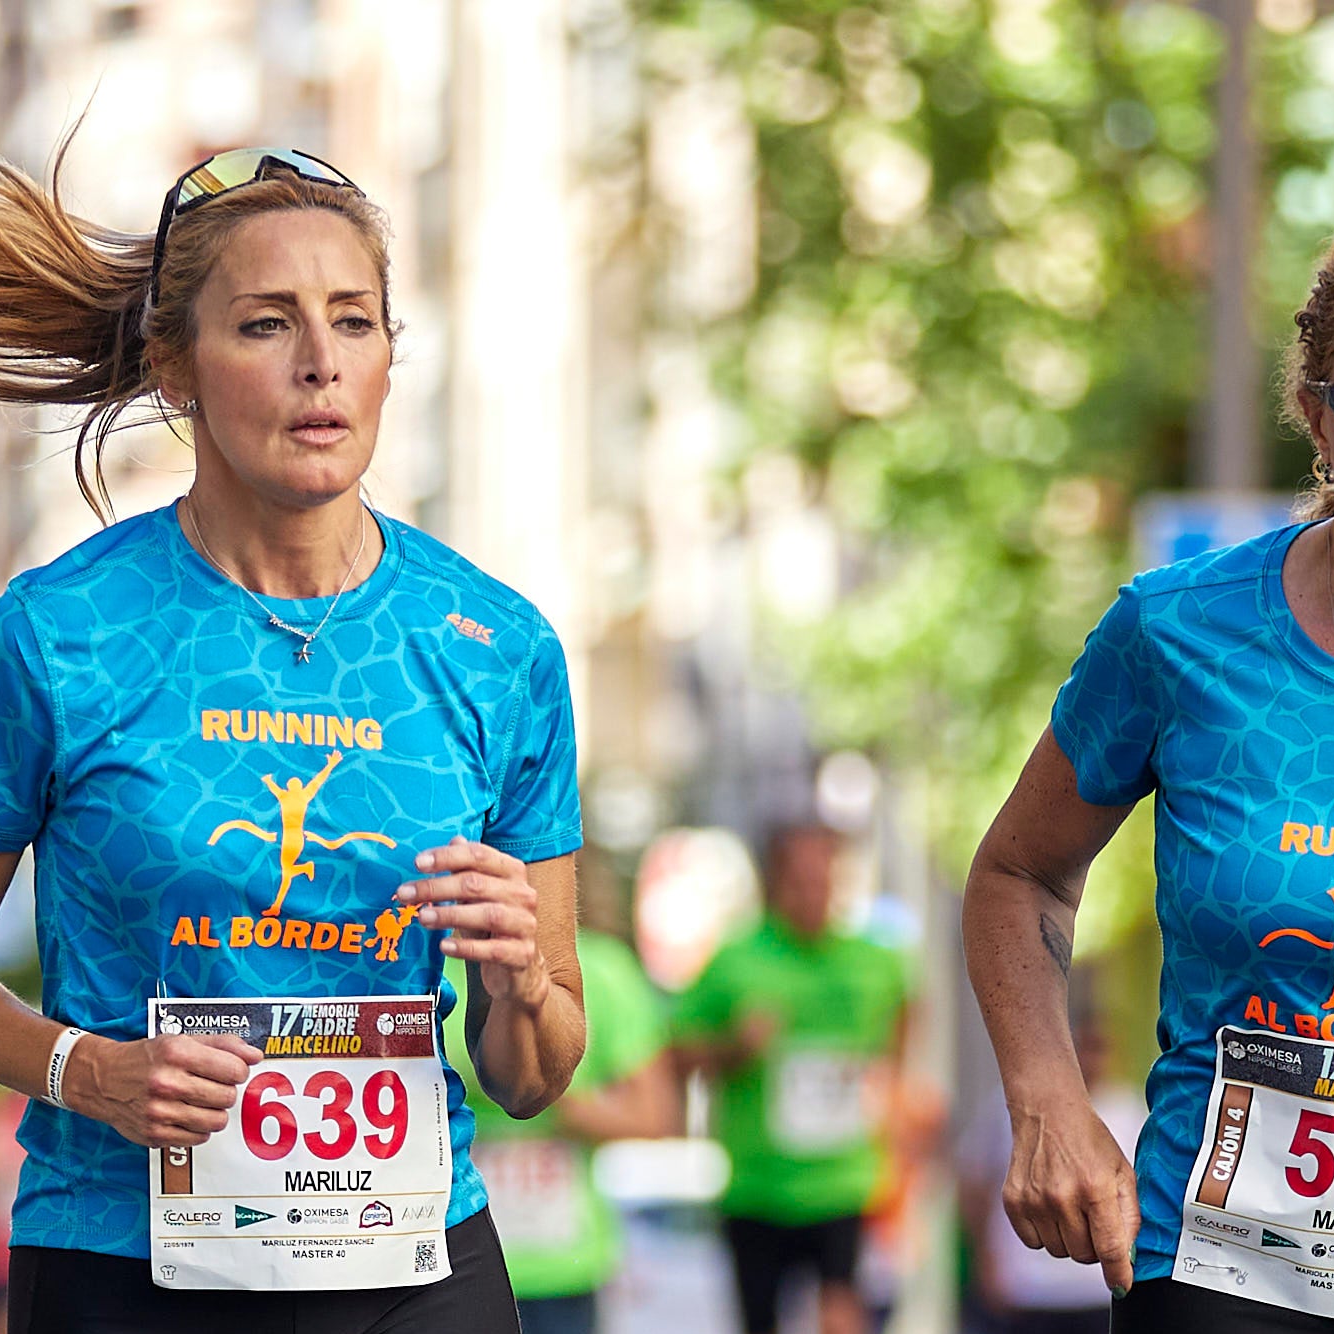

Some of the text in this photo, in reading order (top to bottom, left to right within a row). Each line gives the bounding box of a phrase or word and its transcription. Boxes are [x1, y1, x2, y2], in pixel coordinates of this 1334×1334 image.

[201, 710, 383, 749] RUNNING
[170, 916, 366, 954] AL BORDE
[183, 1015, 250, 1027] OXIMESA
[270, 1004, 360, 1037] 17 MEMORIAL
[395, 1013, 430, 1025] OXIMESA
[1244, 995, 1286, 1033] AL
[301, 1018, 356, 1037] PADRE
[264, 1035, 362, 1055] MARCELINO
[1247, 1043, 1302, 1065] OXIMESA
[240, 1070, 408, 1161] 639
[1212, 1107, 1245, 1181] CAJÓN 4
[285, 1170, 372, 1192] MARILUZ
[168, 1212, 221, 1222] CALERO
[304, 1208, 349, 1217] OXIMESA
[402, 1205, 436, 1221] ANAYA
[1197, 1216, 1250, 1236] CALERO
[262, 1239, 296, 1247] MARILUZ
[292, 1249, 346, 1259] MASTER 40
[1295, 1266, 1329, 1279] MARIOLA
